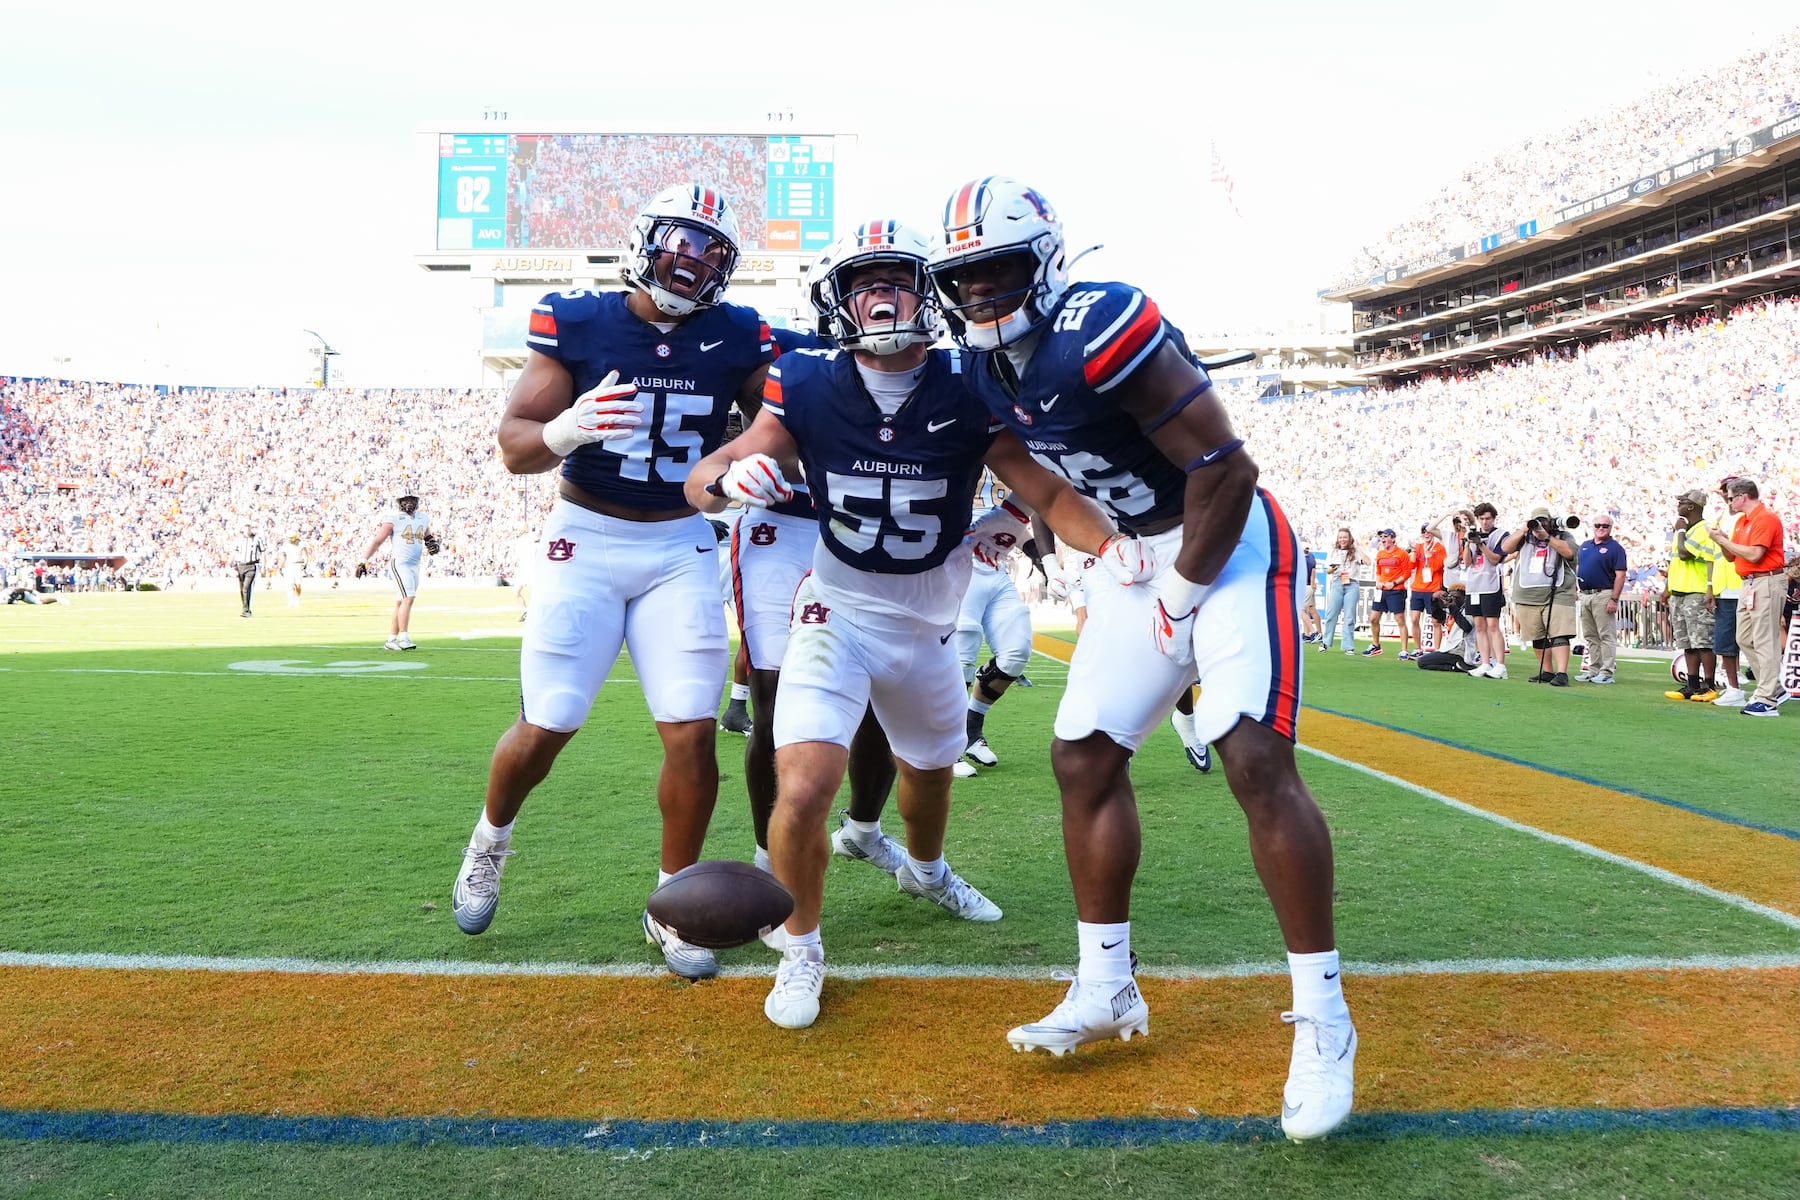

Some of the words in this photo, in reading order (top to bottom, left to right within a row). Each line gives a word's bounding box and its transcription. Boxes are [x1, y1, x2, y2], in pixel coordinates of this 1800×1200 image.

[456, 176, 490, 213] 82
[691, 211, 720, 226] TIGERS
[478, 229, 502, 239] AVO
[858, 244, 892, 252] TIGERS
[947, 239, 982, 254] TIGERS
[492, 257, 572, 271] AUBURN
[1053, 290, 1107, 333] 26
[632, 376, 696, 391] AUBURN
[601, 392, 715, 483] 45
[851, 459, 923, 475] AUBURN
[826, 470, 948, 562] 55
[401, 525, 424, 545] 44
[1110, 981, 1140, 1022] NIKE
